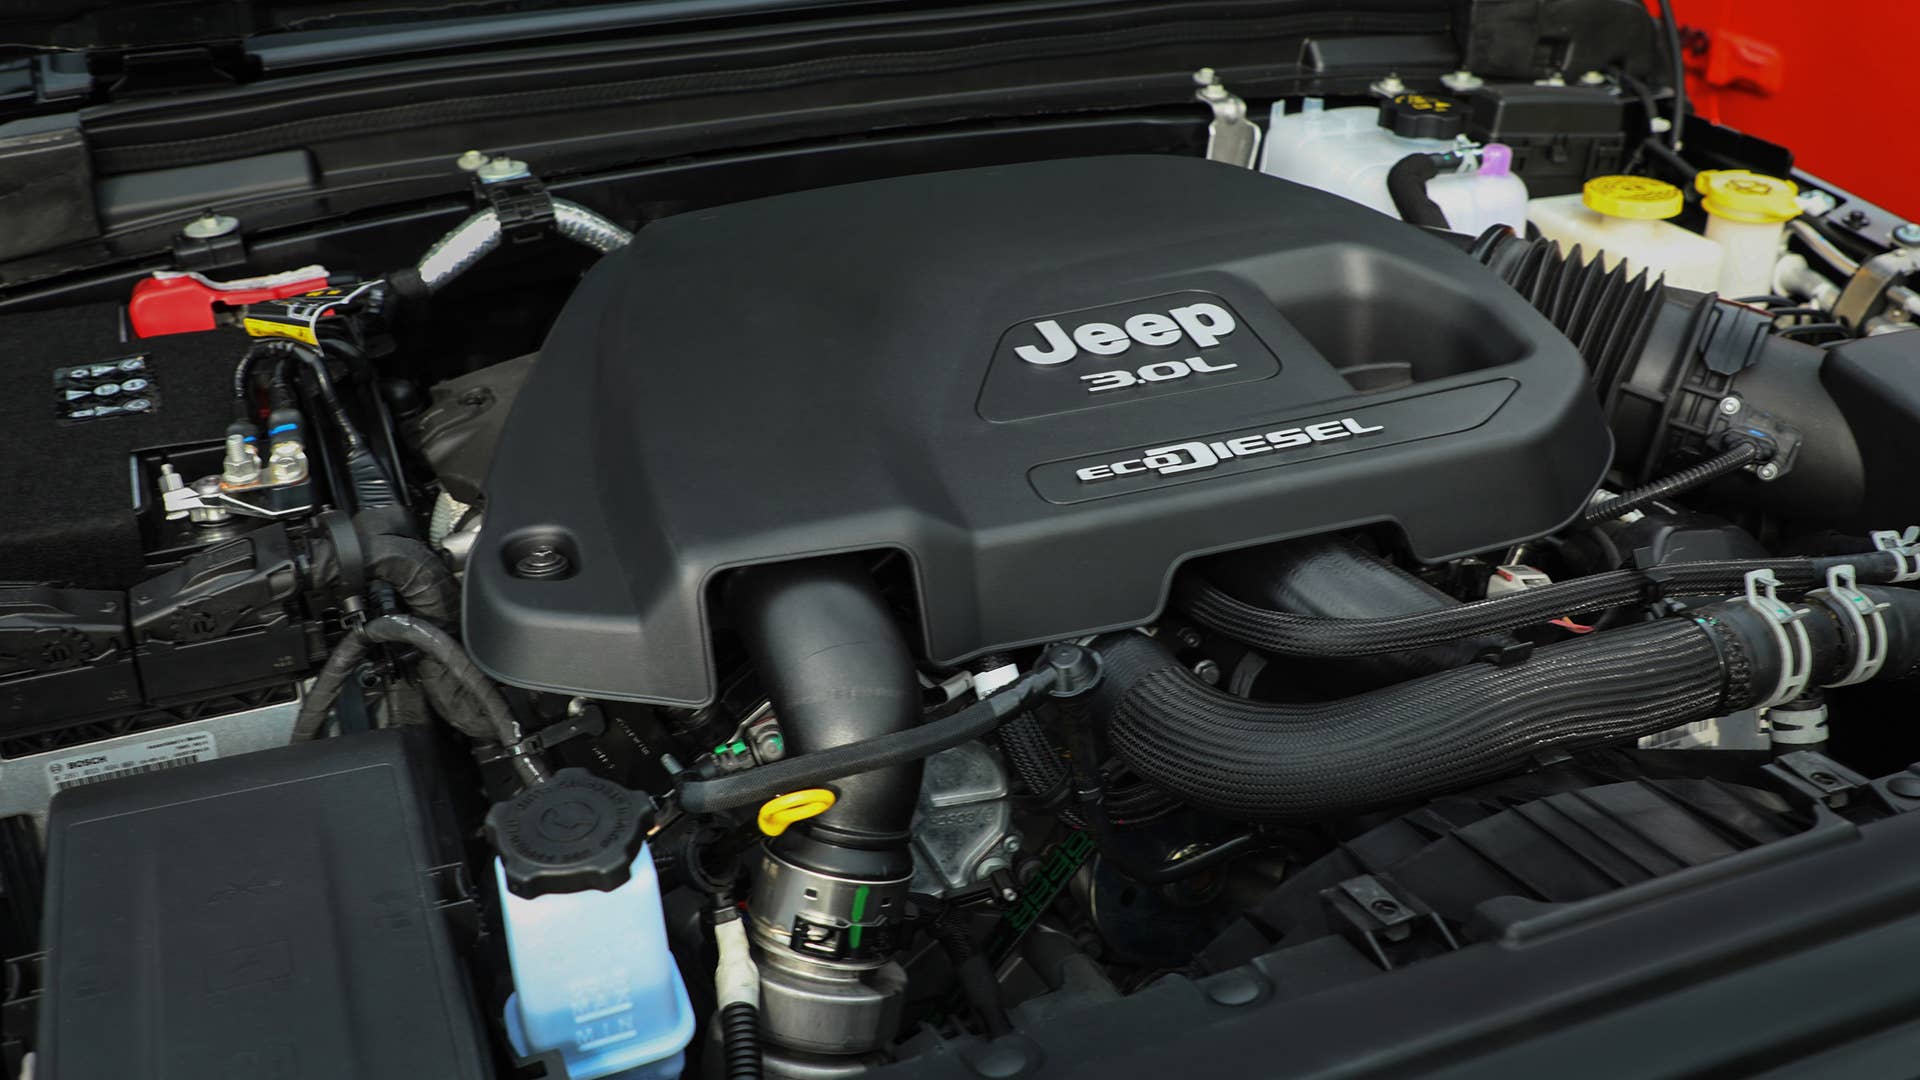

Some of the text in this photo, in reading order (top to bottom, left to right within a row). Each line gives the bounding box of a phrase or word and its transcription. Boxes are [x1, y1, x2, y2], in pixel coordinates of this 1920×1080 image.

[1014, 303, 1236, 365] Jeep
[1080, 356, 1238, 392] 3.0L
[67, 755, 107, 770] BOSCH
